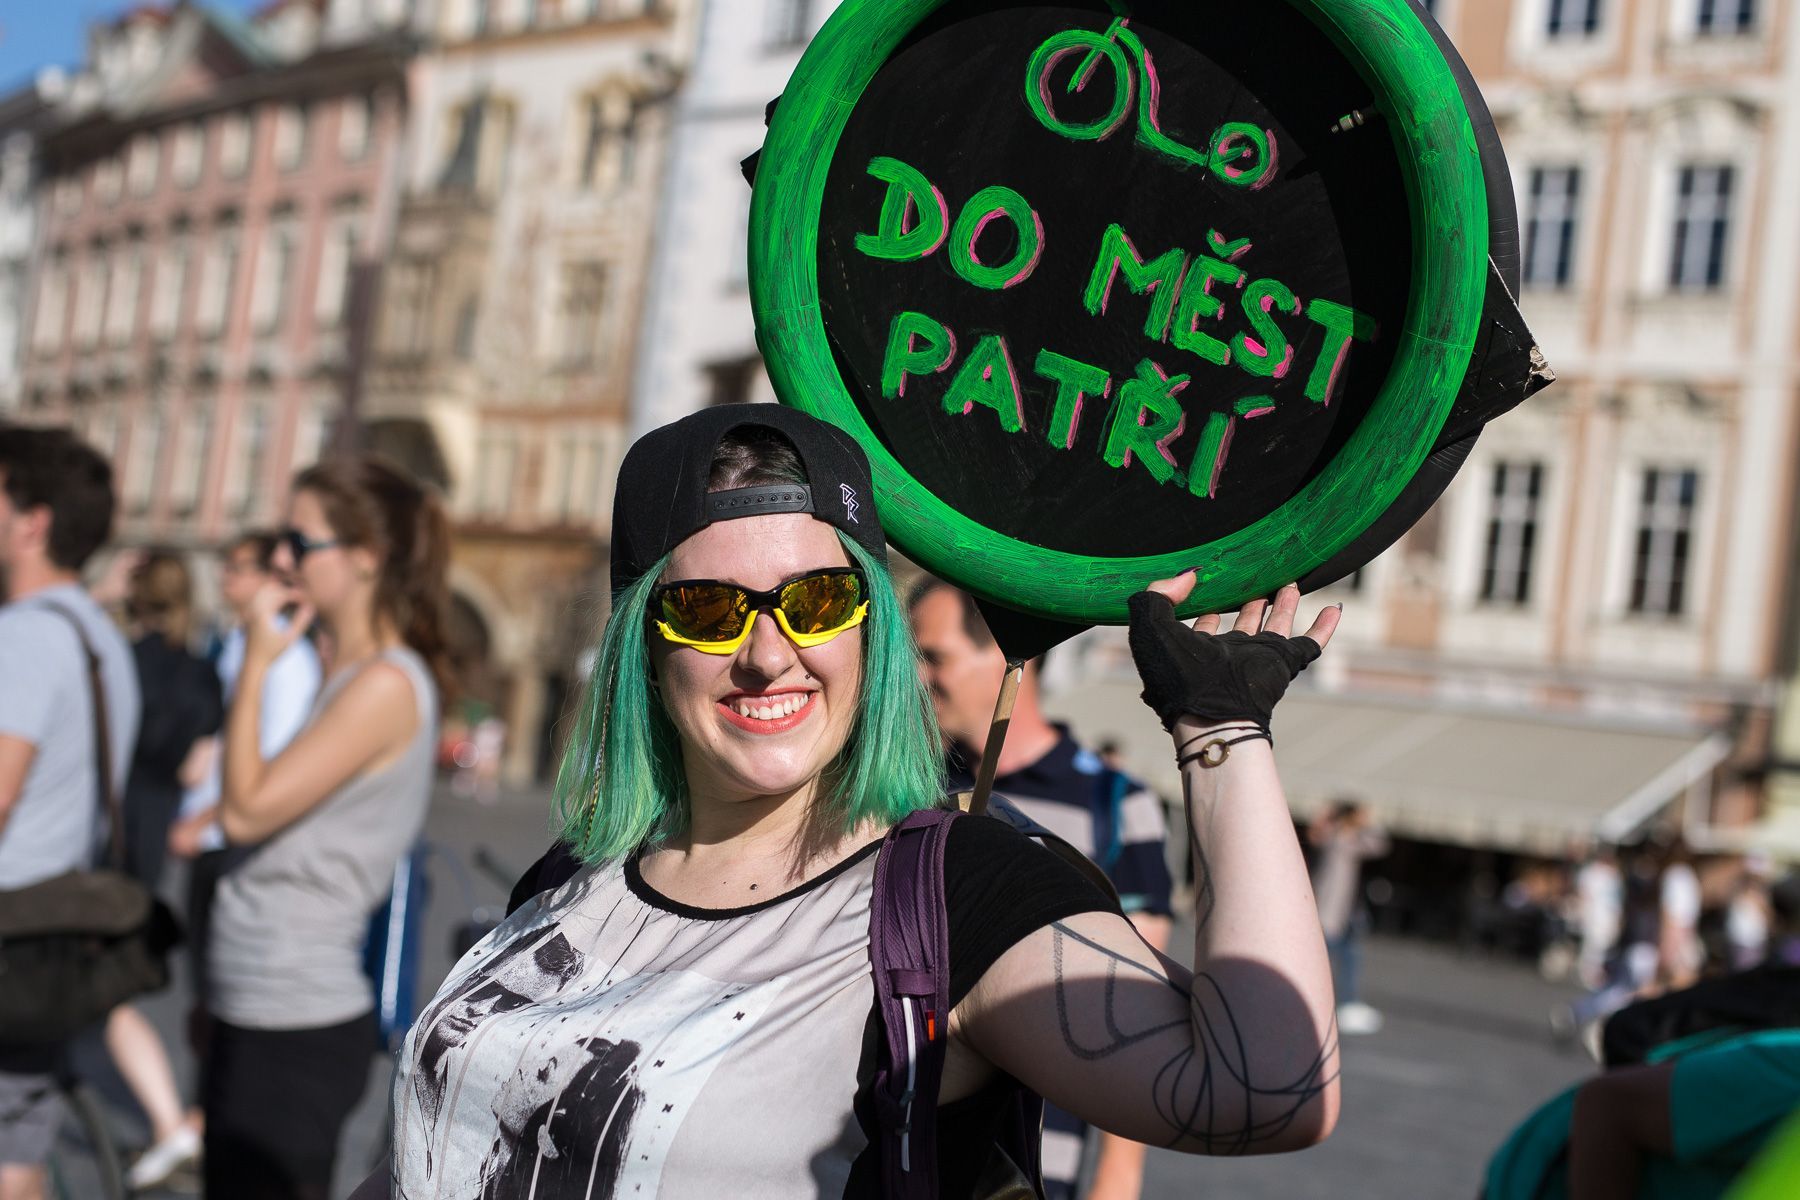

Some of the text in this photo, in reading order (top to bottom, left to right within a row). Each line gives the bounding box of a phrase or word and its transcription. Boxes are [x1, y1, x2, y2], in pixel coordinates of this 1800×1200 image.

[855, 157, 1378, 406] DO MĚST
[881, 311, 1275, 498] PATŘÍ
